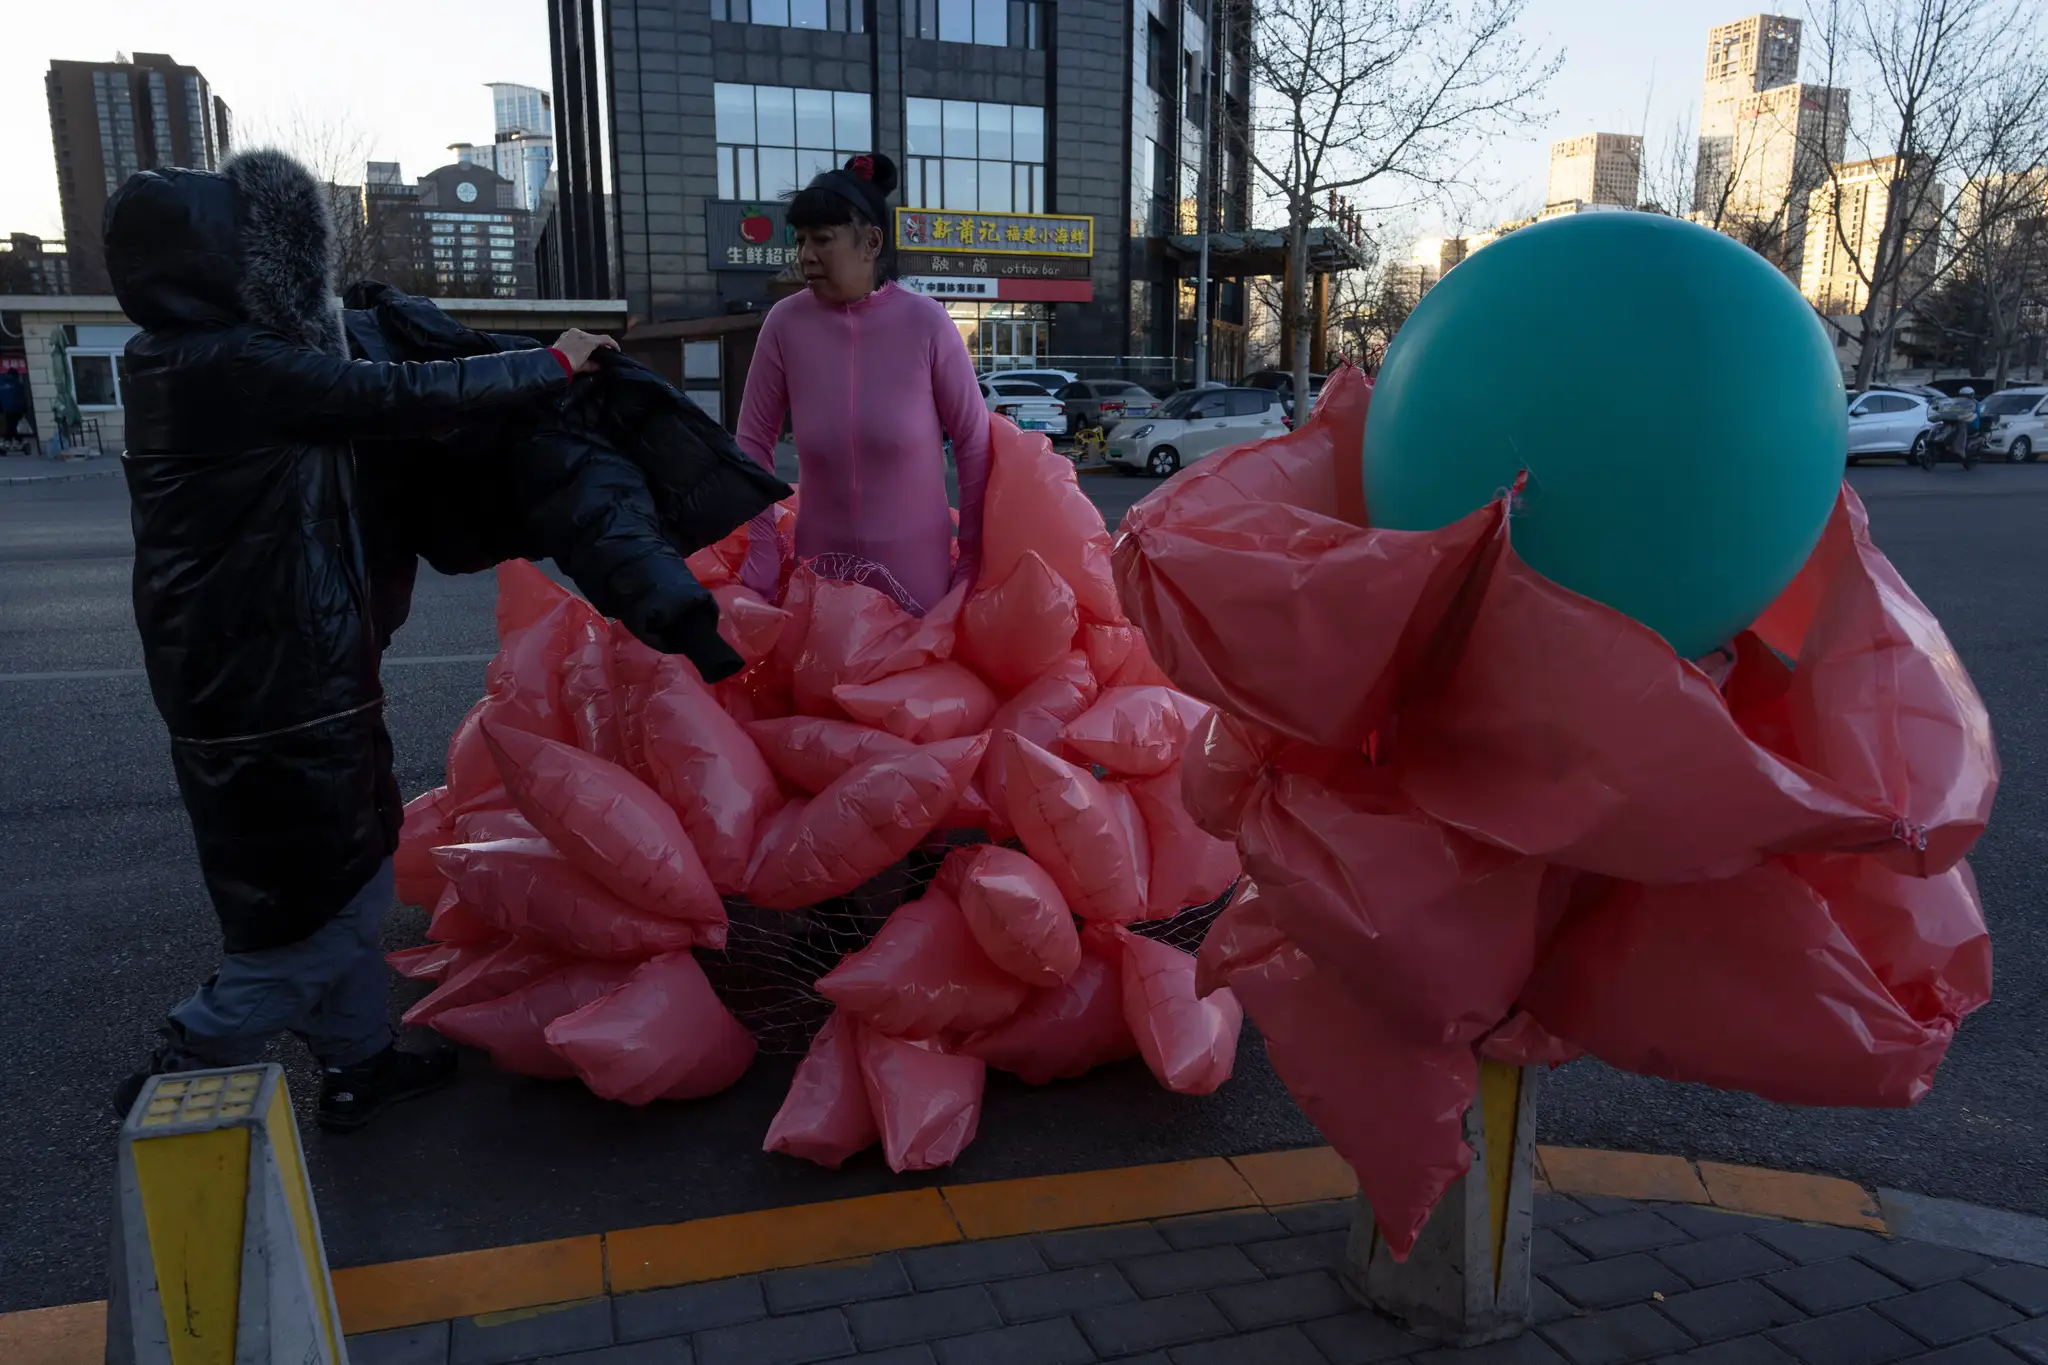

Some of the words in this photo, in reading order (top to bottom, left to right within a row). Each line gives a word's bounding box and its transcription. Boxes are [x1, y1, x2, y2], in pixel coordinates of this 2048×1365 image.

[1004, 225, 1085, 246] 福建小海鲜
[1042, 262, 1060, 276] bar
[926, 282, 986, 294] 中国体育彩票
